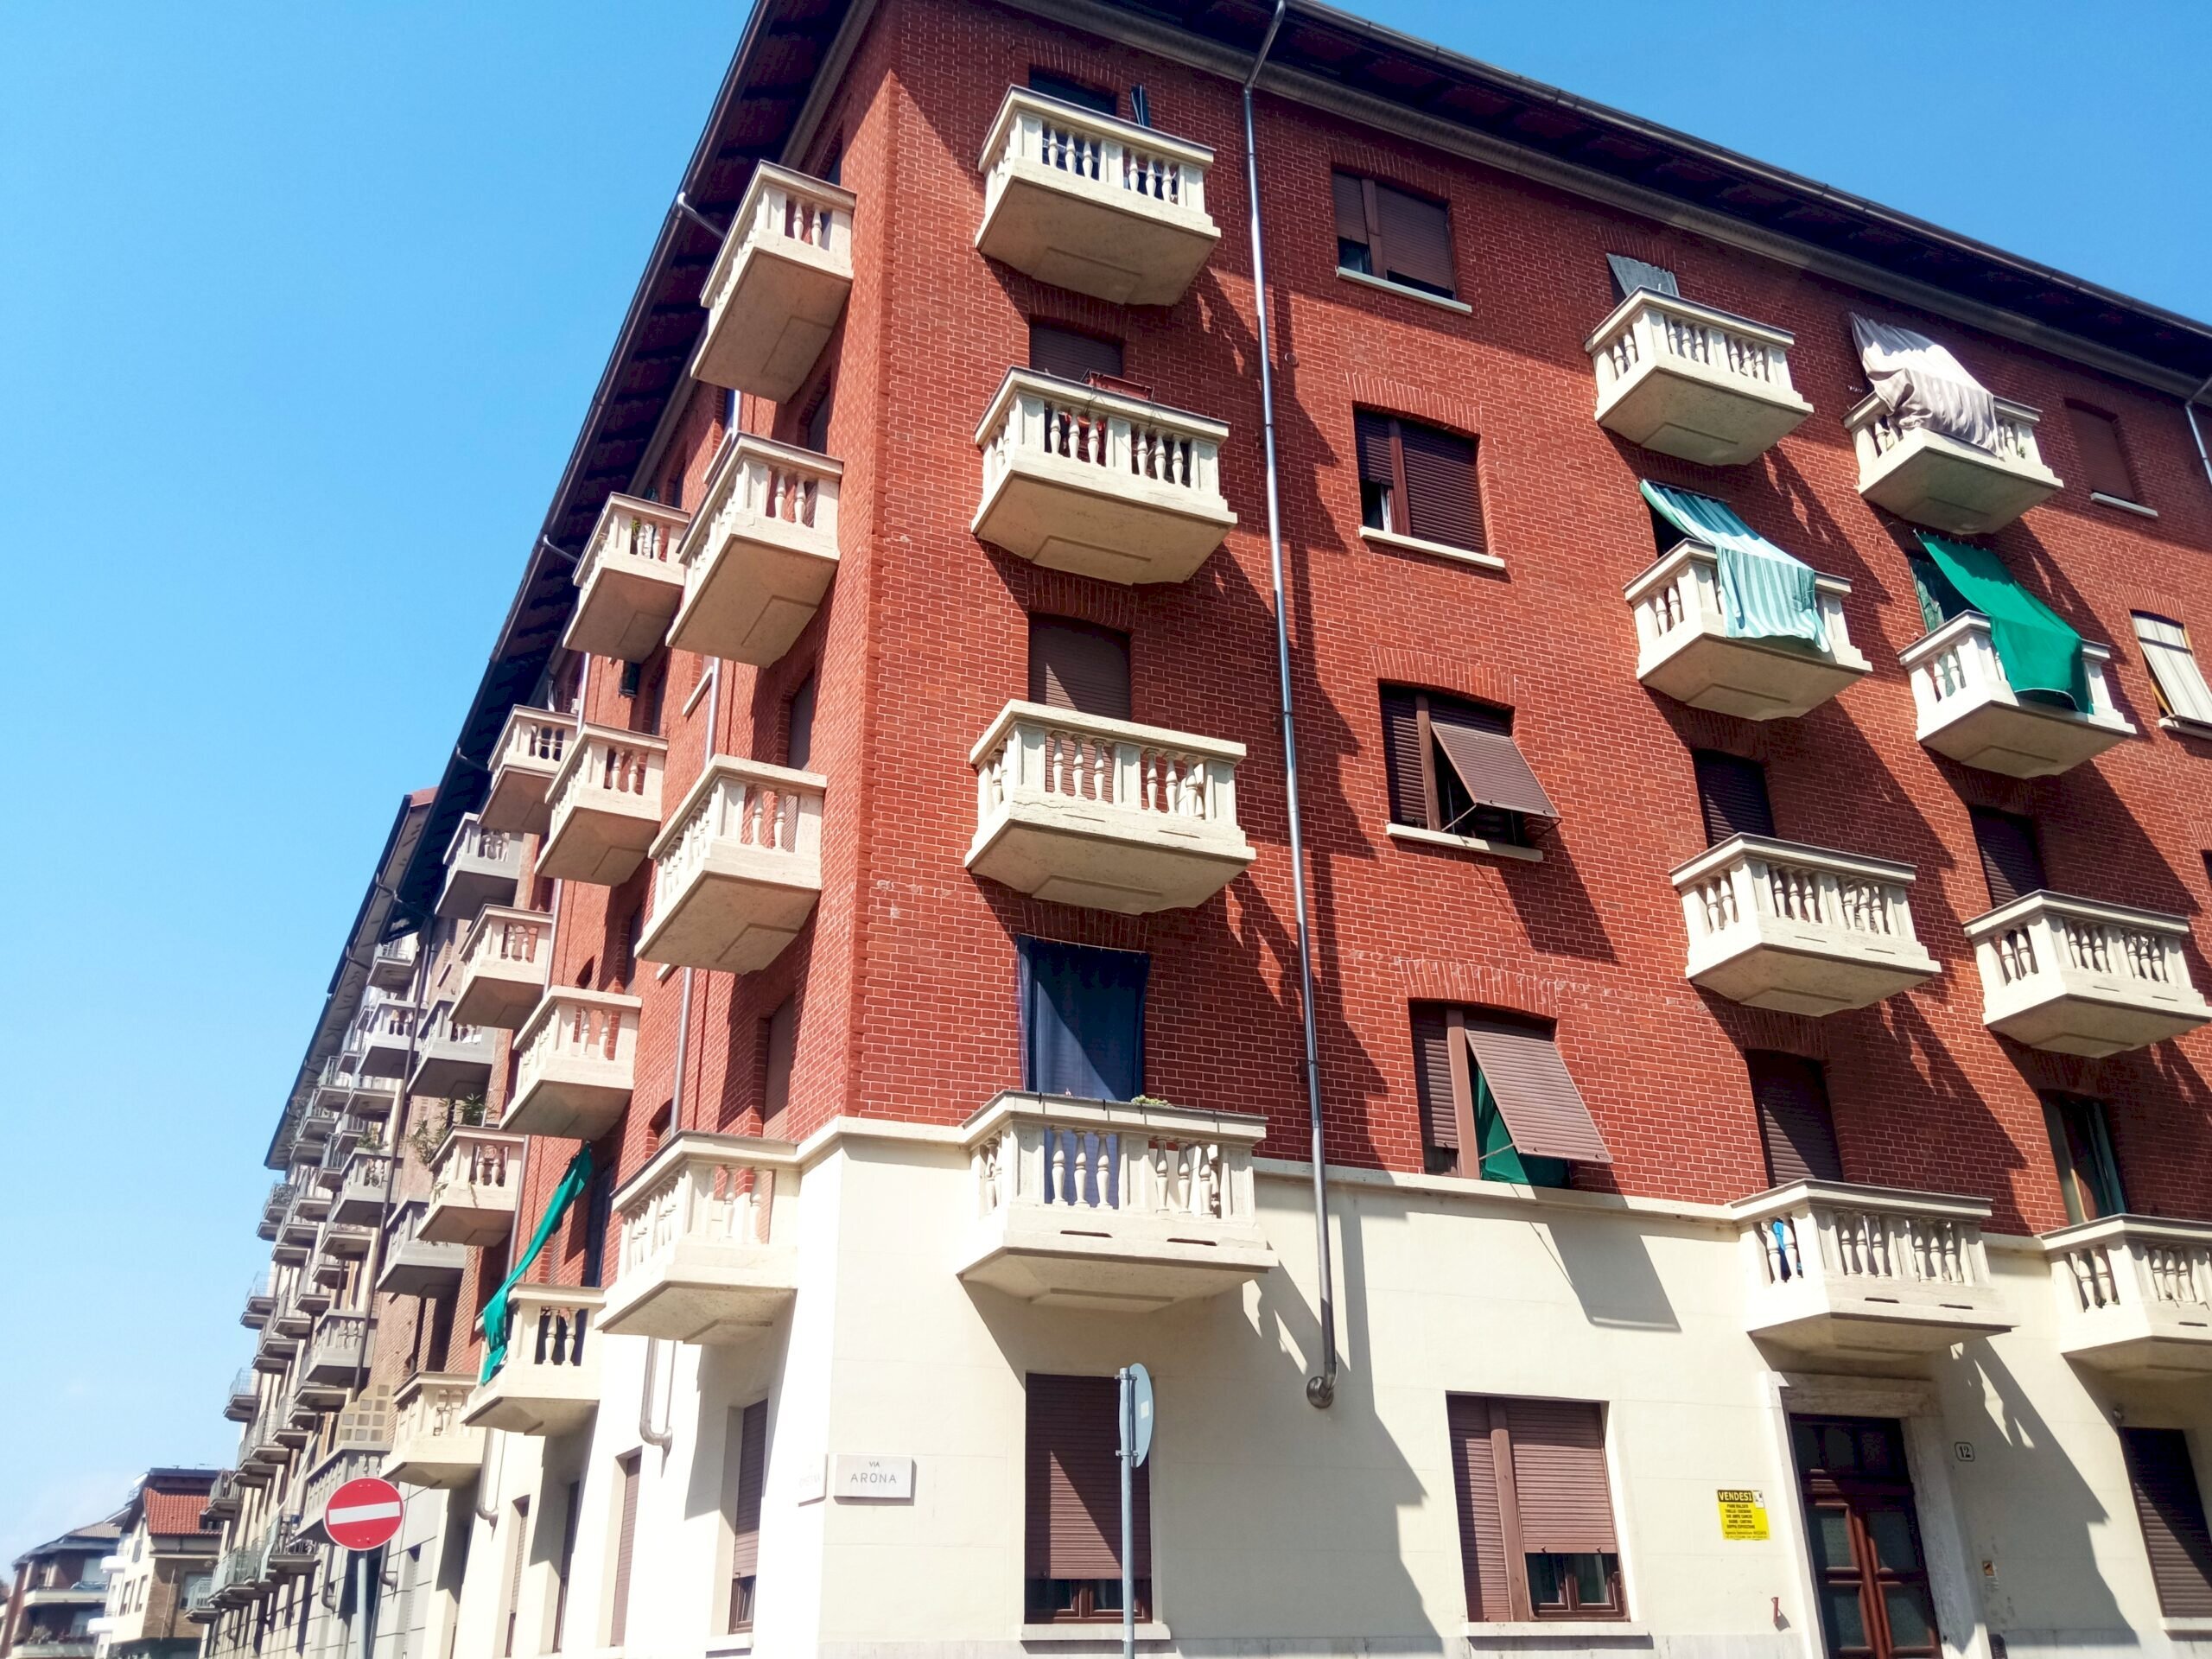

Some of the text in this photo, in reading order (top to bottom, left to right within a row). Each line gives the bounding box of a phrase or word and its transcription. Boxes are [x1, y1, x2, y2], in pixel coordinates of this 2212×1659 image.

[1959, 1446, 1971, 1458] 12
[850, 1472, 897, 1484] ARONA
[1718, 1491, 1752, 1502] VENDESI
